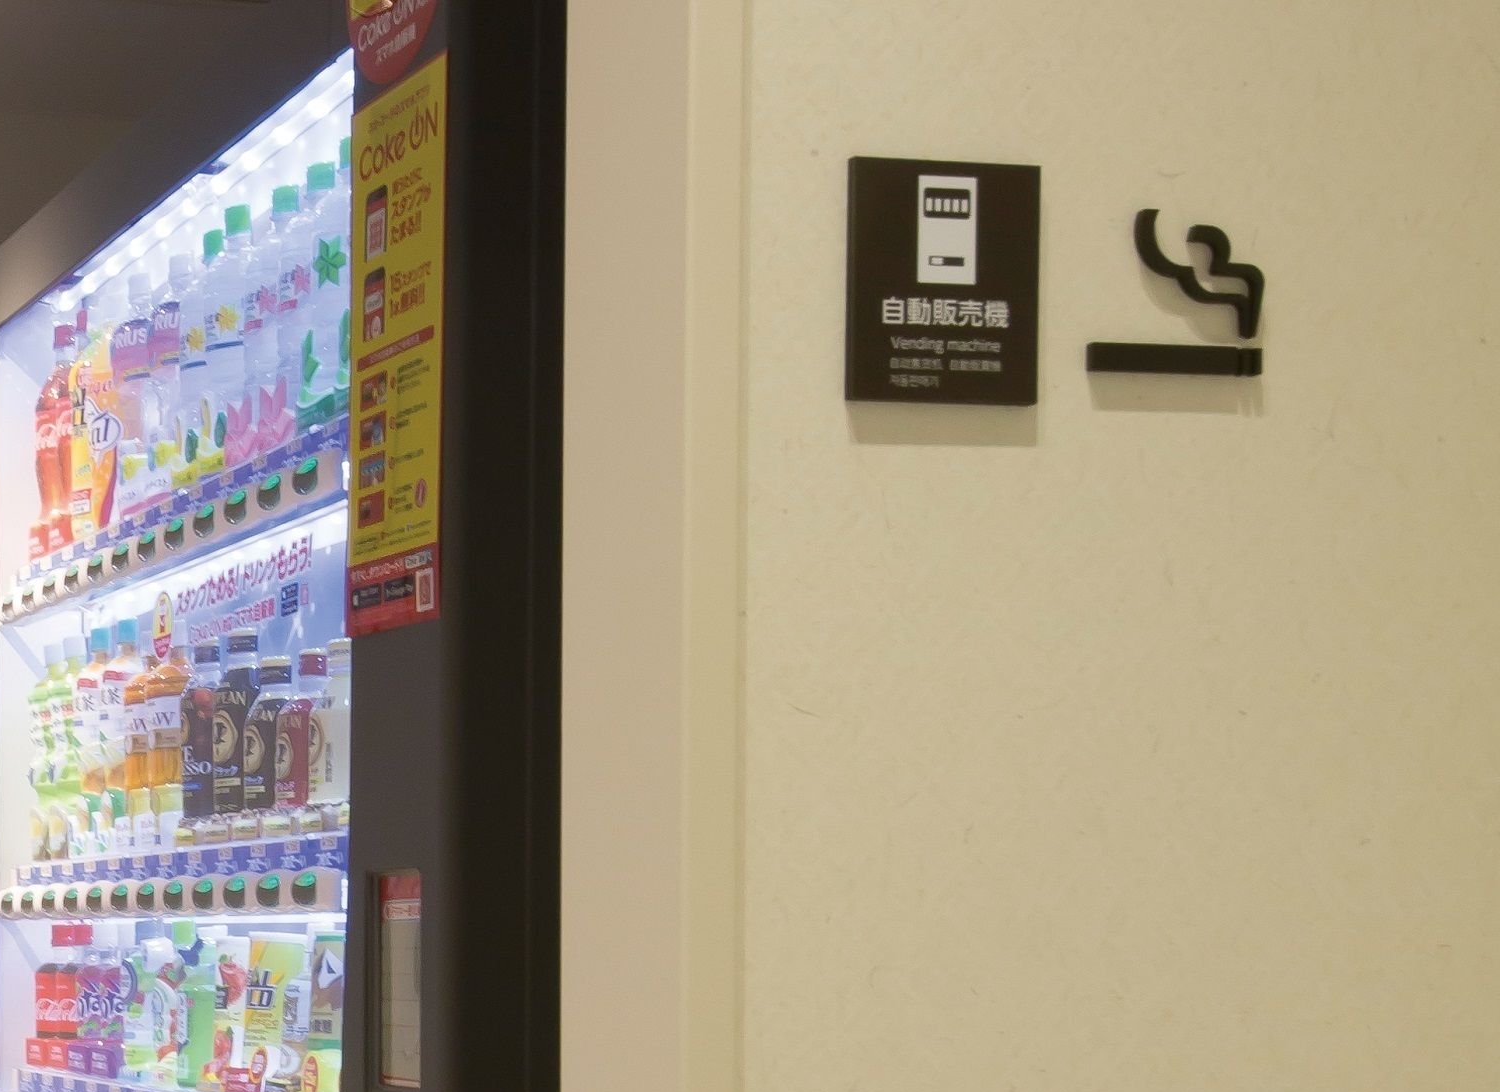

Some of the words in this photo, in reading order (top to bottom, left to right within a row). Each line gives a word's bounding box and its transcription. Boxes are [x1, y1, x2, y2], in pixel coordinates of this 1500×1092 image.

[359, 130, 406, 181] Coke
[409, 101, 438, 150] ON
[882, 297, 1009, 328] 自動販売機
[890, 336, 944, 354] Vending
[947, 339, 1001, 352] machine
